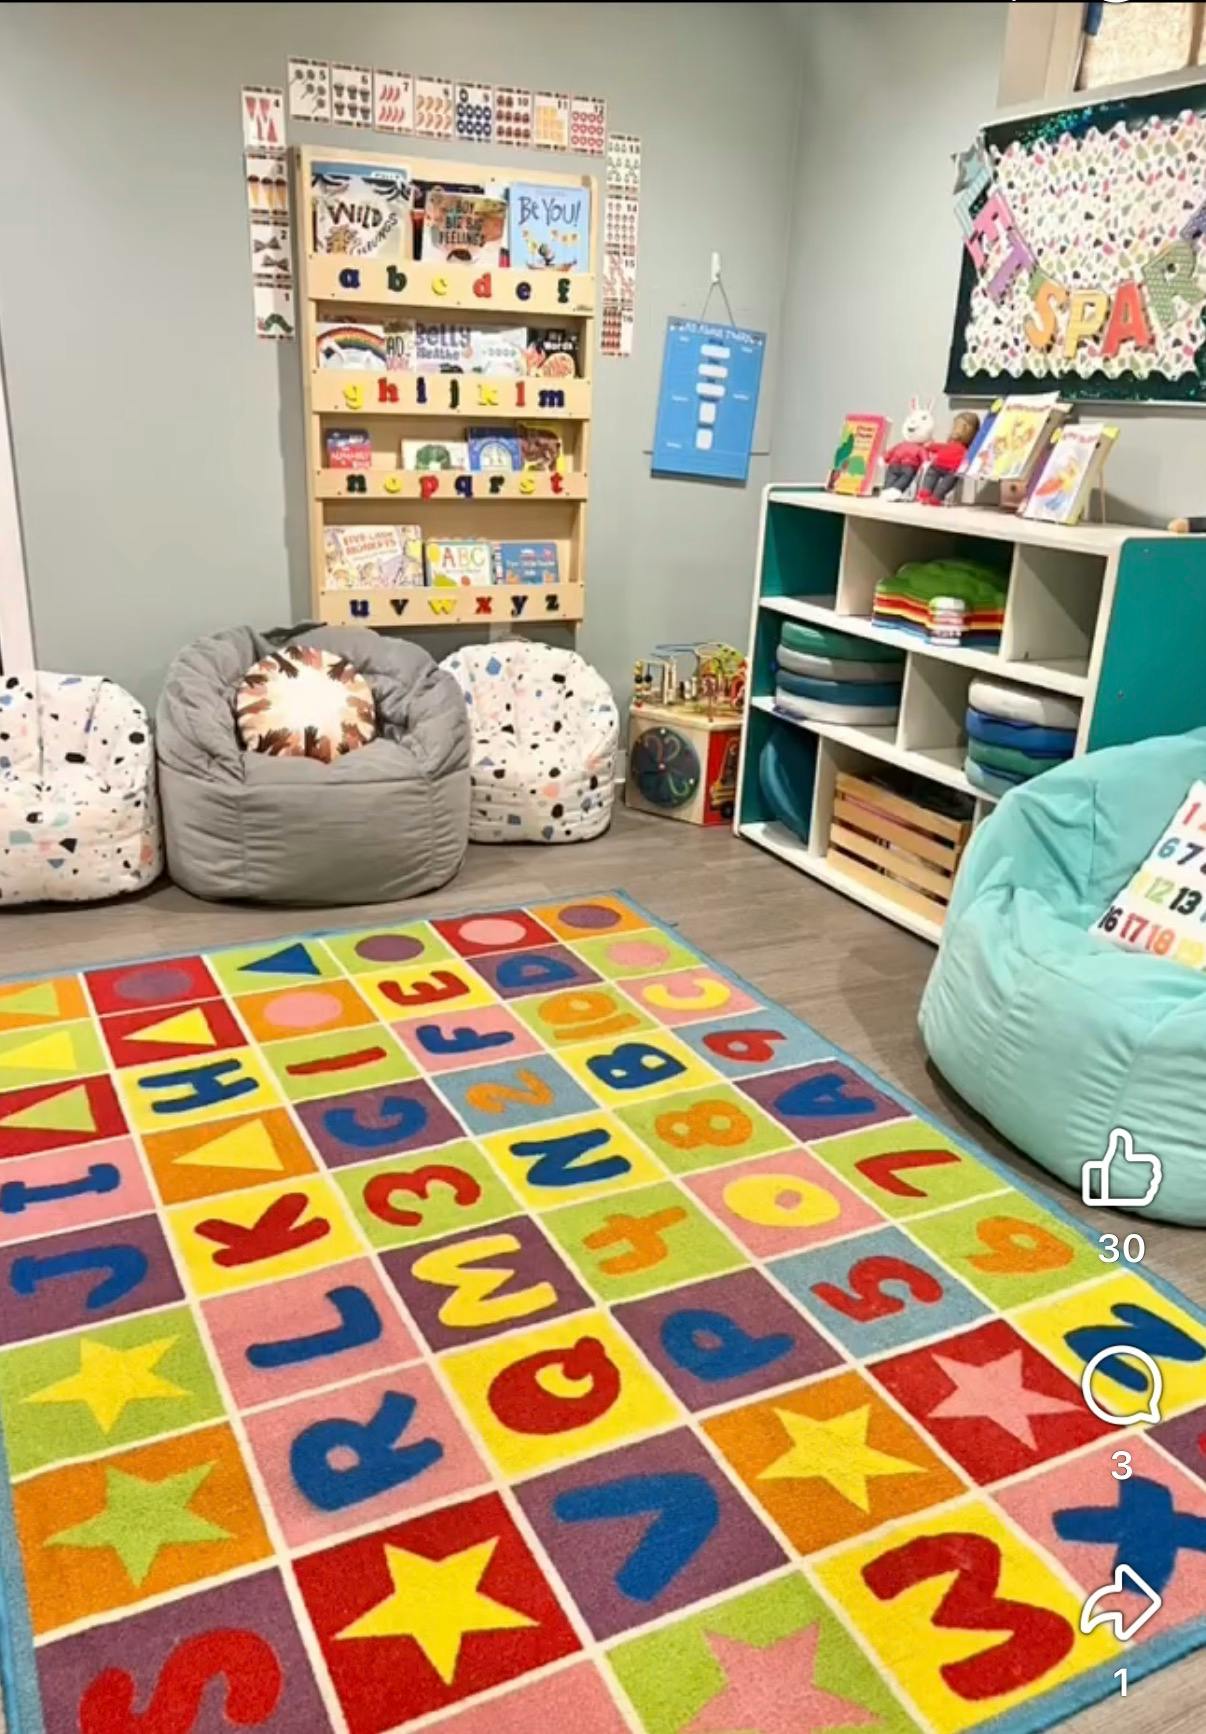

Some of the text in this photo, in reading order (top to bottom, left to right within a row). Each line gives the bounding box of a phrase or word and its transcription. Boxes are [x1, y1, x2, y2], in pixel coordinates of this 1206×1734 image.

[319, 69, 326, 81] 5
[361, 74, 369, 85] 6
[402, 81, 409, 92] 7
[273, 99, 280, 109] 4
[518, 96, 528, 107] 10
[327, 201, 384, 229] WILD
[338, 264, 571, 303] a b c d e f
[342, 382, 365, 410] g
[378, 376, 399, 403] h
[449, 378, 460, 410] j
[477, 383, 499, 406] k
[538, 388, 565, 408] m
[346, 471, 563, 502] n o p q r s t
[441, 546, 485, 569] ABC
[349, 594, 560, 619] u v w x y z
[1182, 802, 1201, 825] 1
[1157, 836, 1204, 866] 6 7
[1144, 875, 1203, 915] 12 13
[1097, 904, 1124, 932] 16
[1119, 911, 1150, 944] 17
[1144, 923, 1175, 956] 18
[377, 969, 471, 1006] E
[495, 953, 579, 988] D
[642, 977, 731, 1010] C
[414, 1023, 515, 1055] F
[537, 990, 641, 1042] 10
[137, 1057, 260, 1114] H
[586, 1041, 688, 1090] B
[466, 1067, 554, 1114] 2
[774, 1073, 877, 1120] A
[322, 1095, 428, 1148] G
[653, 1100, 754, 1149] 8
[508, 1128, 633, 1188] N
[853, 1148, 962, 1197] 7
[0, 1162, 121, 1213] I
[362, 1163, 482, 1227] 3
[193, 1191, 331, 1268] K
[582, 1205, 688, 1277] 4
[9, 1242, 150, 1310] J
[410, 1232, 559, 1328] M
[809, 1254, 944, 1324] 5
[246, 1284, 384, 1369] L
[660, 1307, 796, 1383] P
[486, 1334, 621, 1437] Q
[289, 1389, 445, 1513] R
[553, 1472, 719, 1603] V
[1051, 1476, 1206, 1597] X
[860, 1531, 1076, 1701] W
[77, 1627, 283, 1734] S
